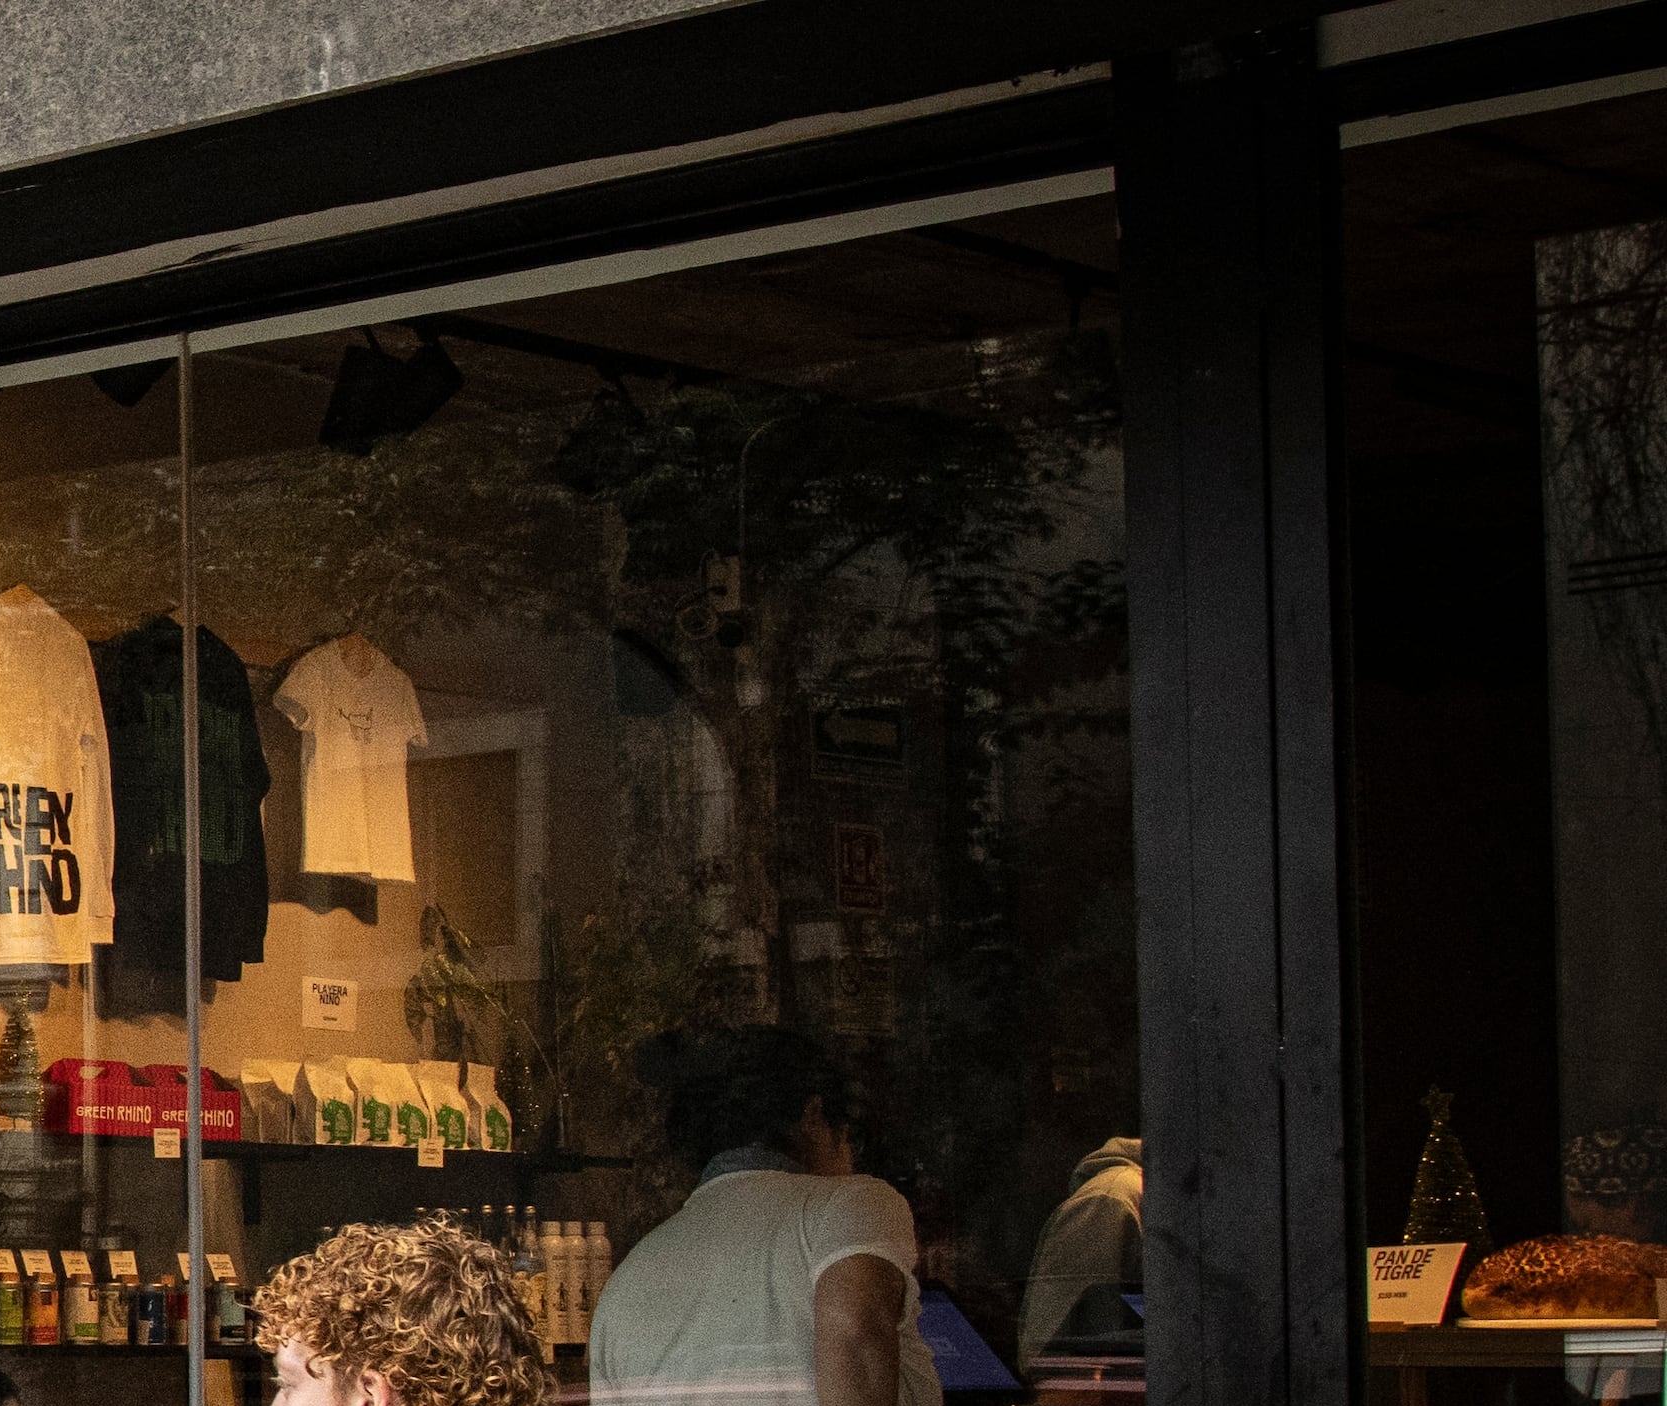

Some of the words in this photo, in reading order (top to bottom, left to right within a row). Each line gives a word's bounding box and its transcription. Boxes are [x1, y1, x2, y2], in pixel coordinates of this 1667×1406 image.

[312, 983, 348, 996] PLAYERA
[76, 1105, 114, 1120] GREEN
[117, 1105, 152, 1124] RHINO
[1374, 1250, 1410, 1266] PAN
[1411, 1248, 1435, 1264] DE
[1375, 1263, 1424, 1281] TIGRE
